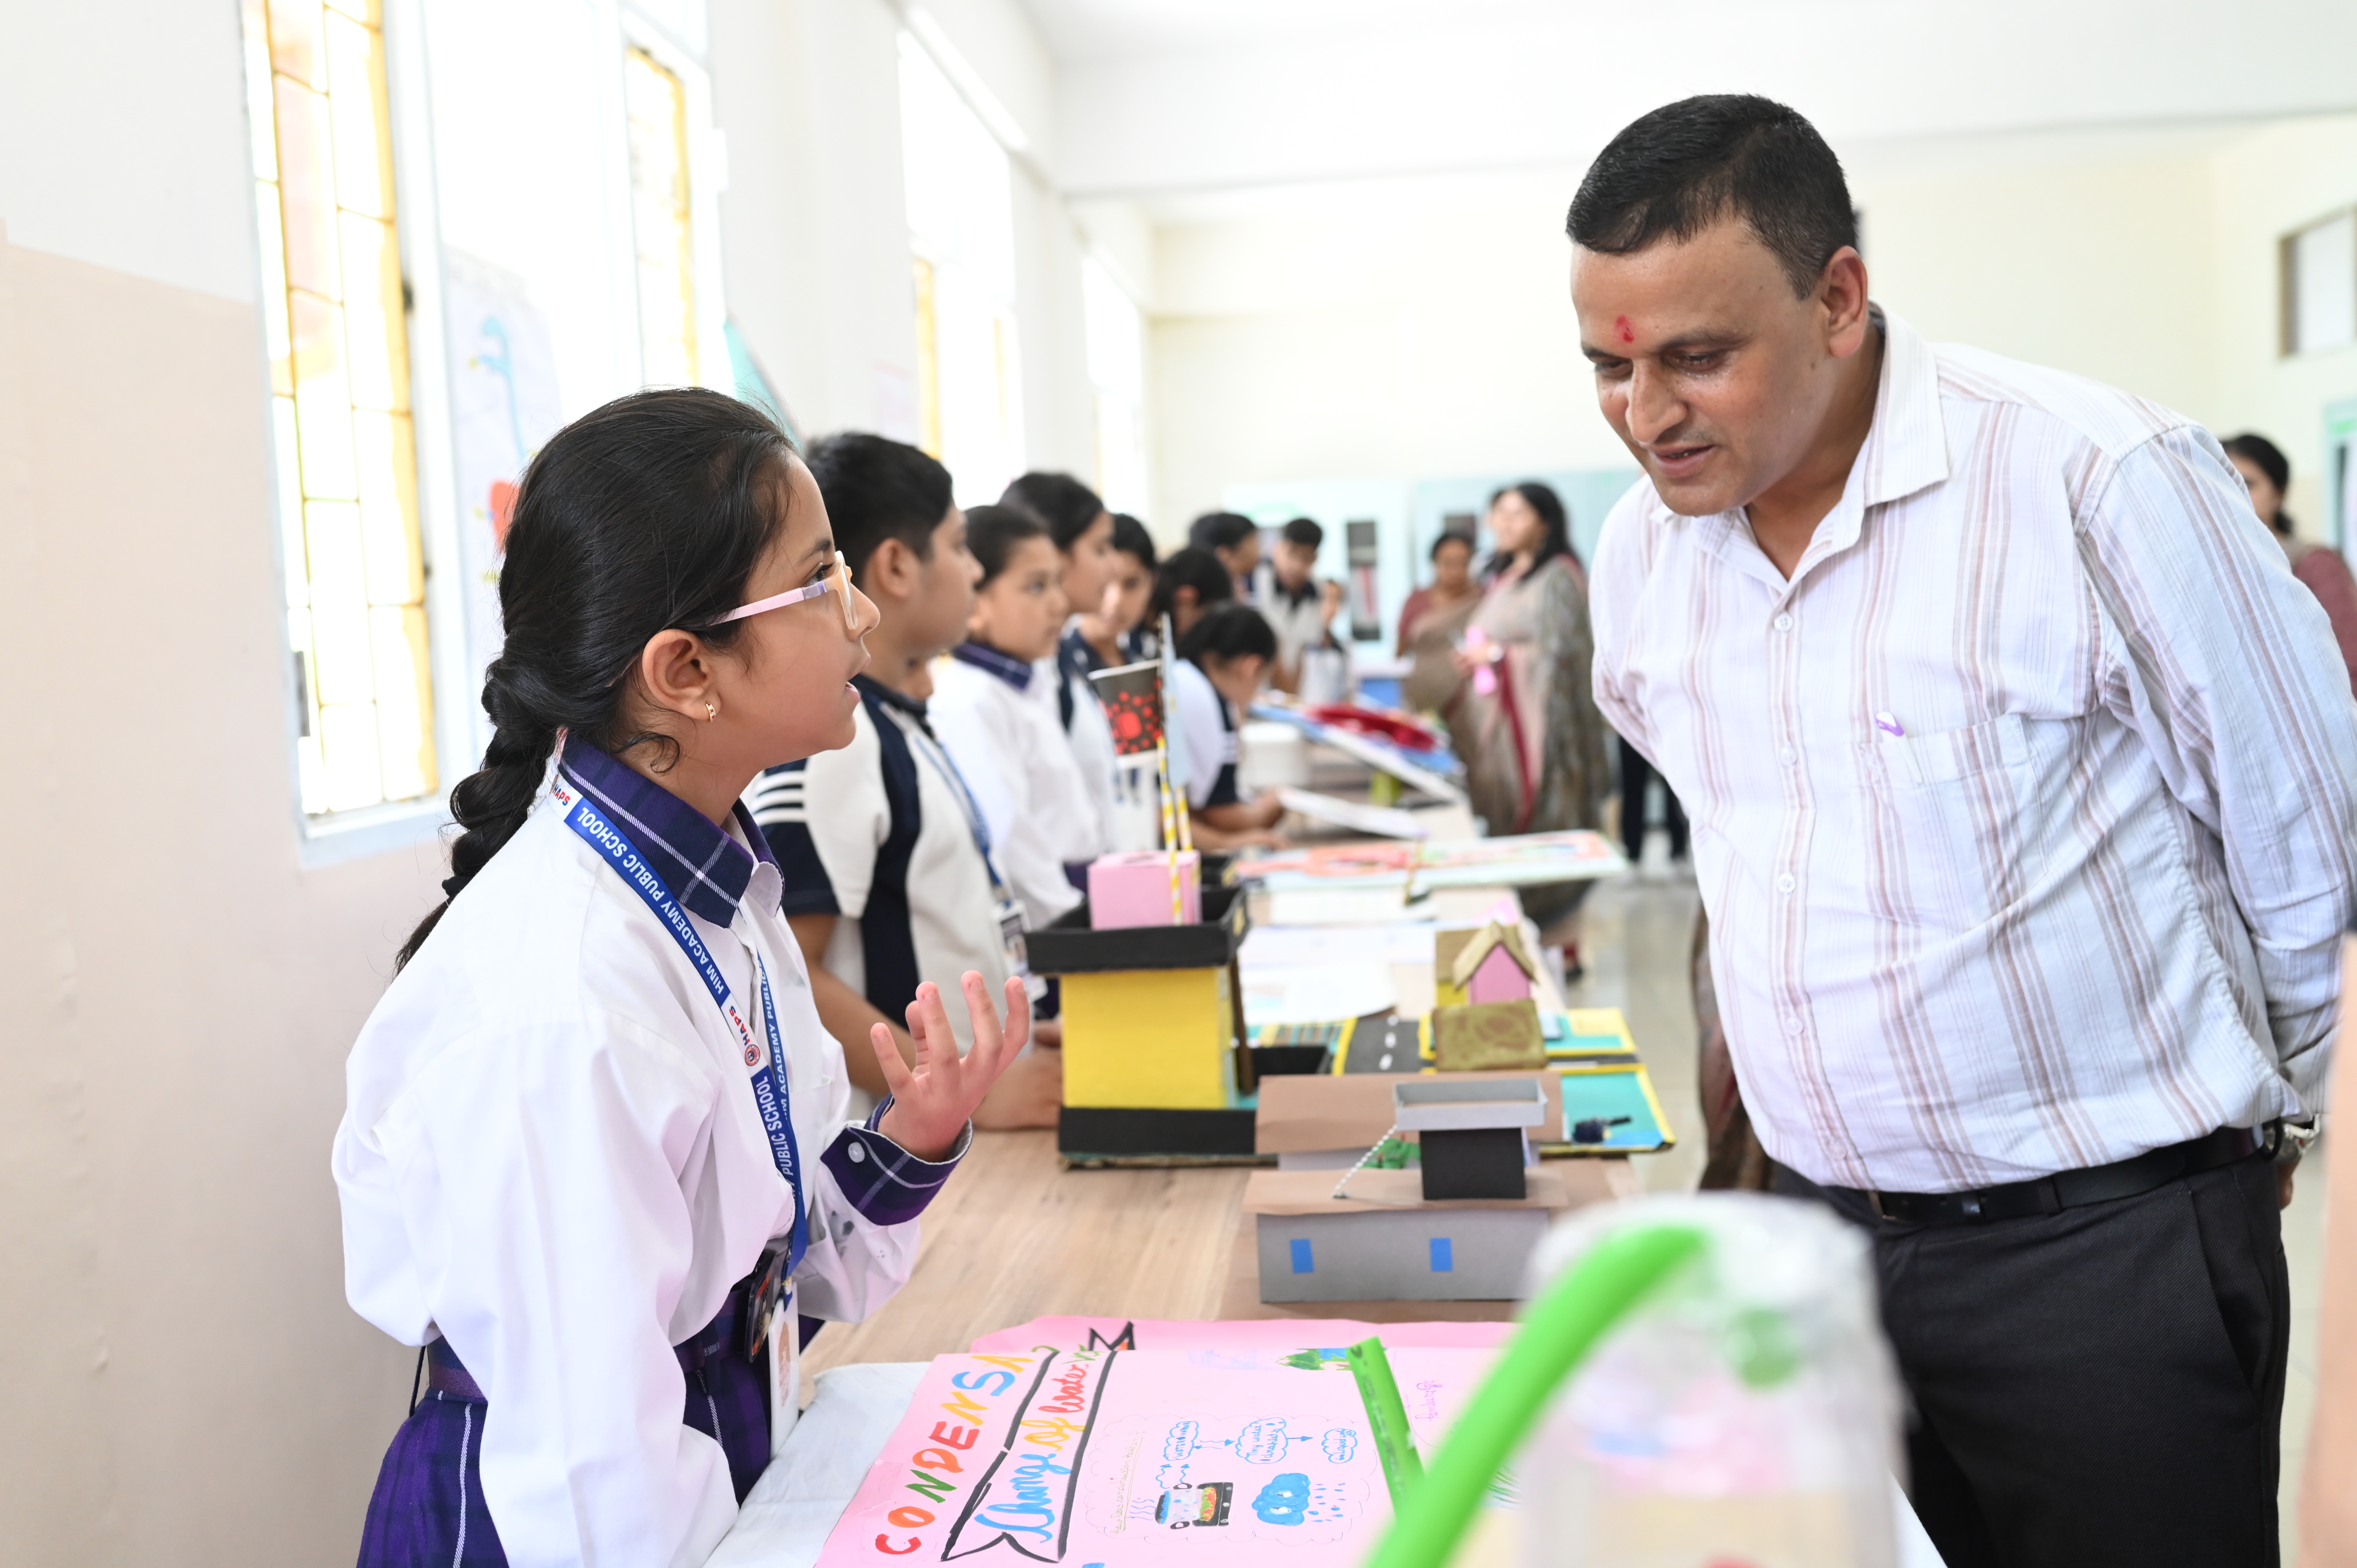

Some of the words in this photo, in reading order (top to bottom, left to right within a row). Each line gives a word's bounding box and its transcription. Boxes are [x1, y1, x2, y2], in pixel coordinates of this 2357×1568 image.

[552, 784, 571, 806] HAPS
[577, 807, 627, 857] SCHOOL
[623, 854, 665, 902] PUBLIC
[660, 900, 709, 965] ACADEMY
[706, 964, 724, 995] HIM
[762, 970, 774, 1019] PUBLIC
[729, 1005, 751, 1047] HAPS
[769, 1023, 787, 1095] ACADEMY
[756, 1075, 783, 1132] SCHOOL
[770, 1133, 794, 1176] PUBLIC
[875, 1346, 1060, 1556] CONDENSA
